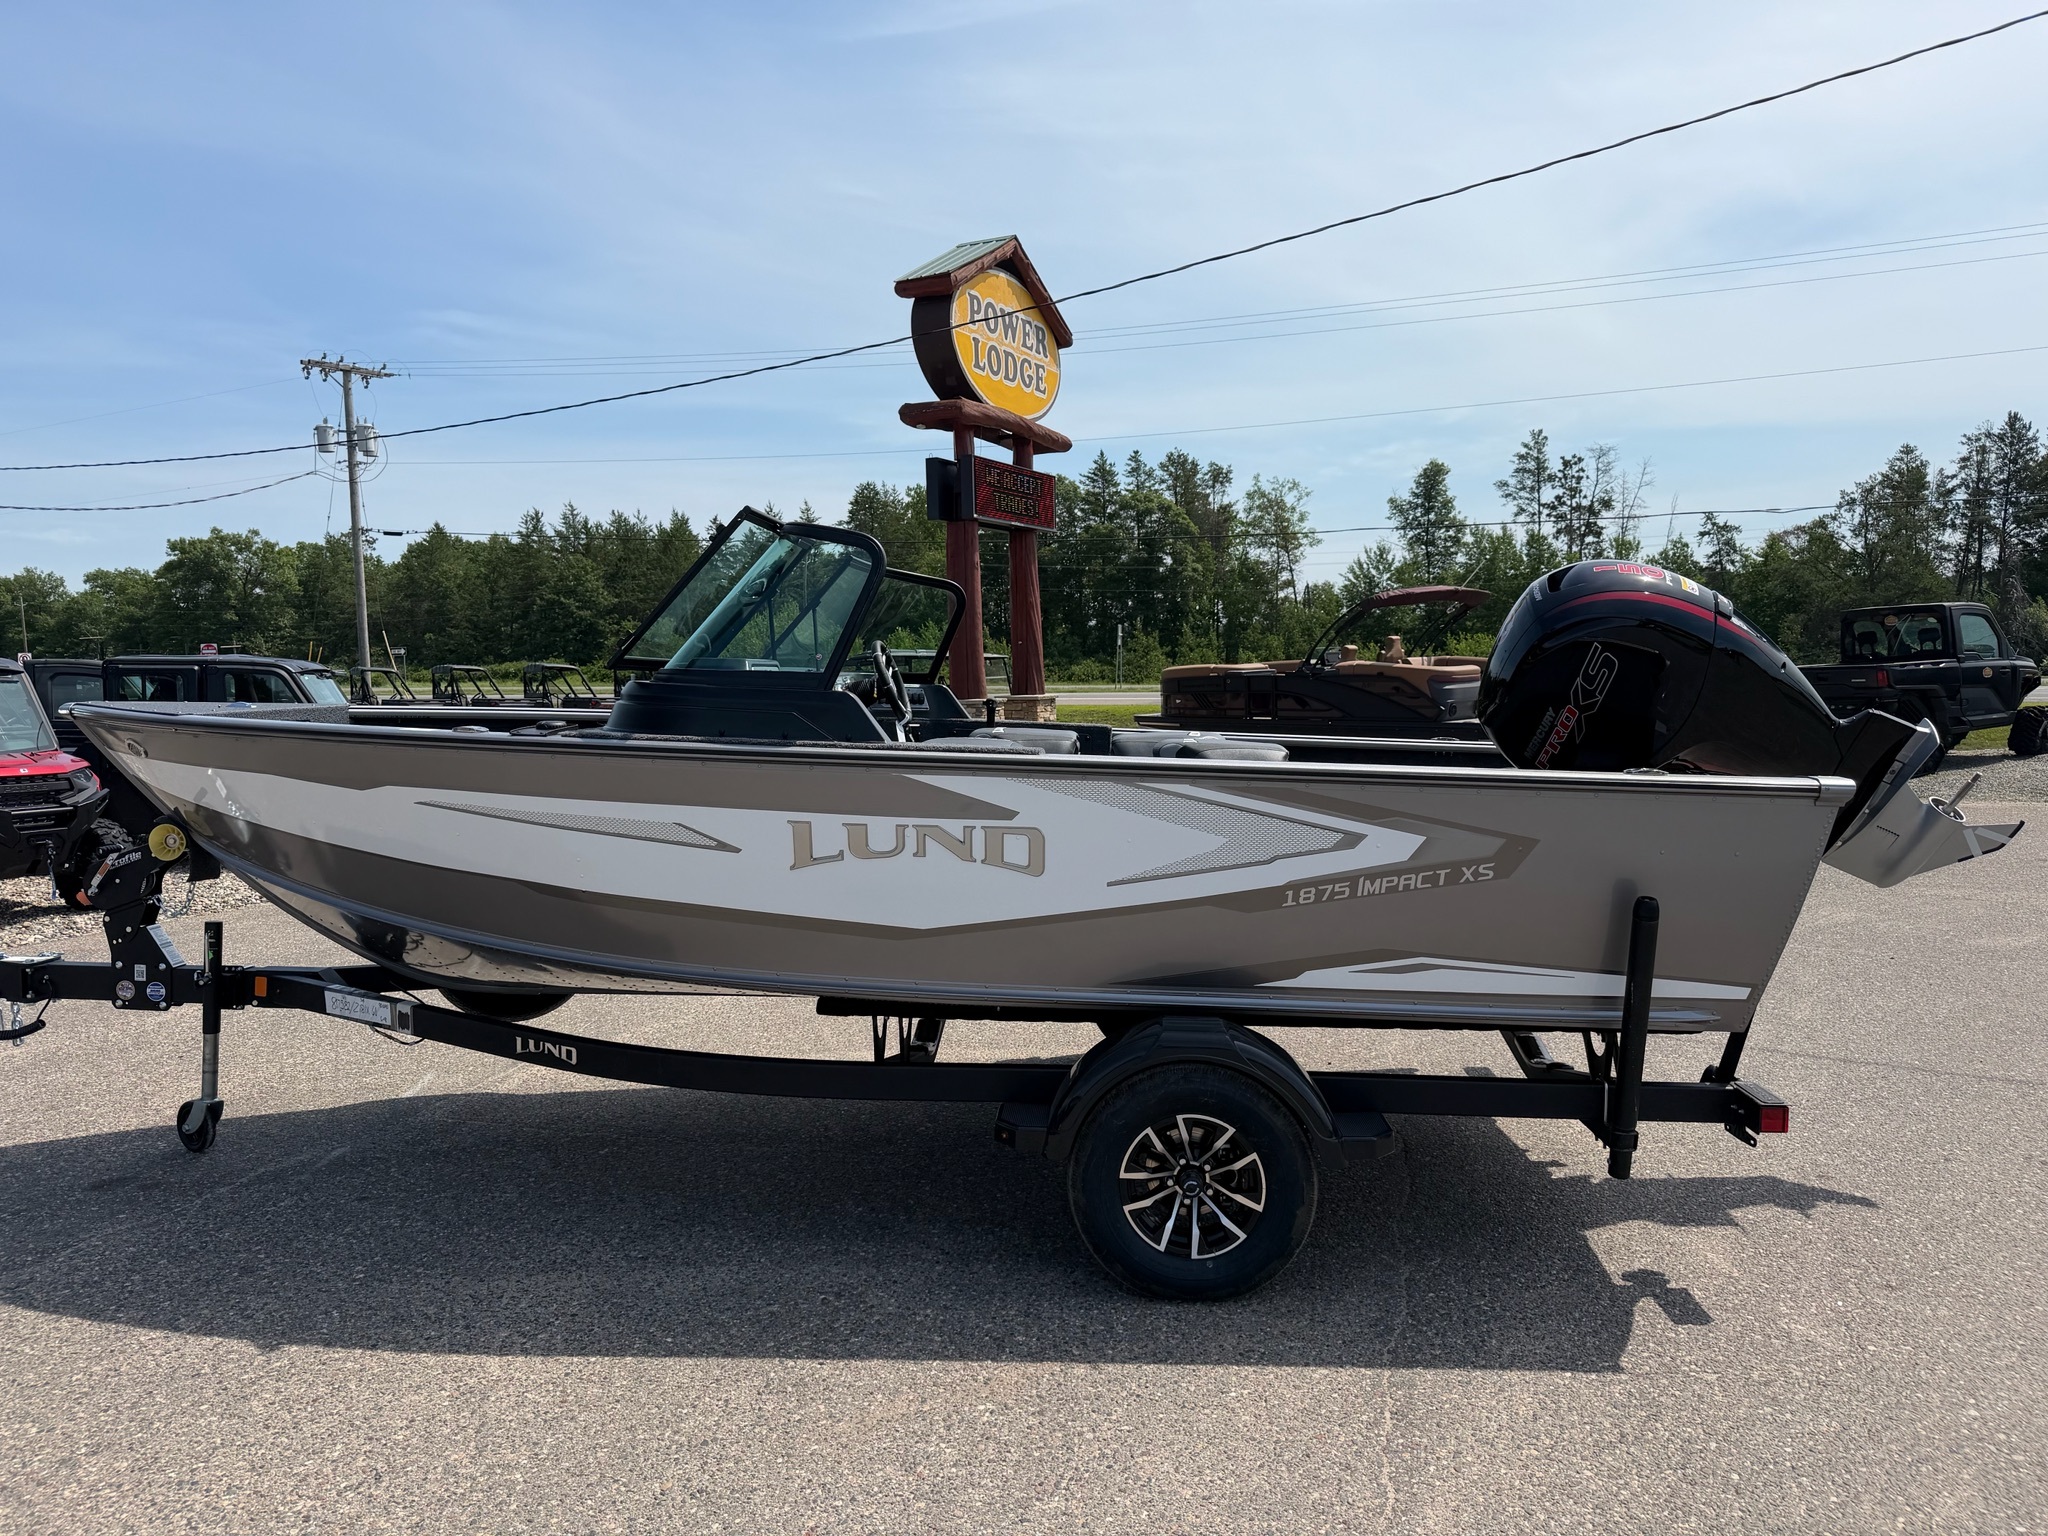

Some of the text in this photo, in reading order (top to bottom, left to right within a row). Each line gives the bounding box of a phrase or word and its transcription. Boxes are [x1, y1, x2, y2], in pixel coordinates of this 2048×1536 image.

[967, 291, 1048, 359] POWER
[971, 336, 1047, 396] LODGE
[985, 466, 1042, 496] WE ACCEPT
[993, 492, 1039, 517] TRADES!
[1593, 563, 1665, 580] 150
[1524, 706, 1556, 759] MERCURY
[112, 851, 142, 867] rofile
[787, 820, 1045, 877] LUND
[1281, 862, 1495, 907] 1875 IMPACT XS
[515, 1036, 577, 1066] LUND
